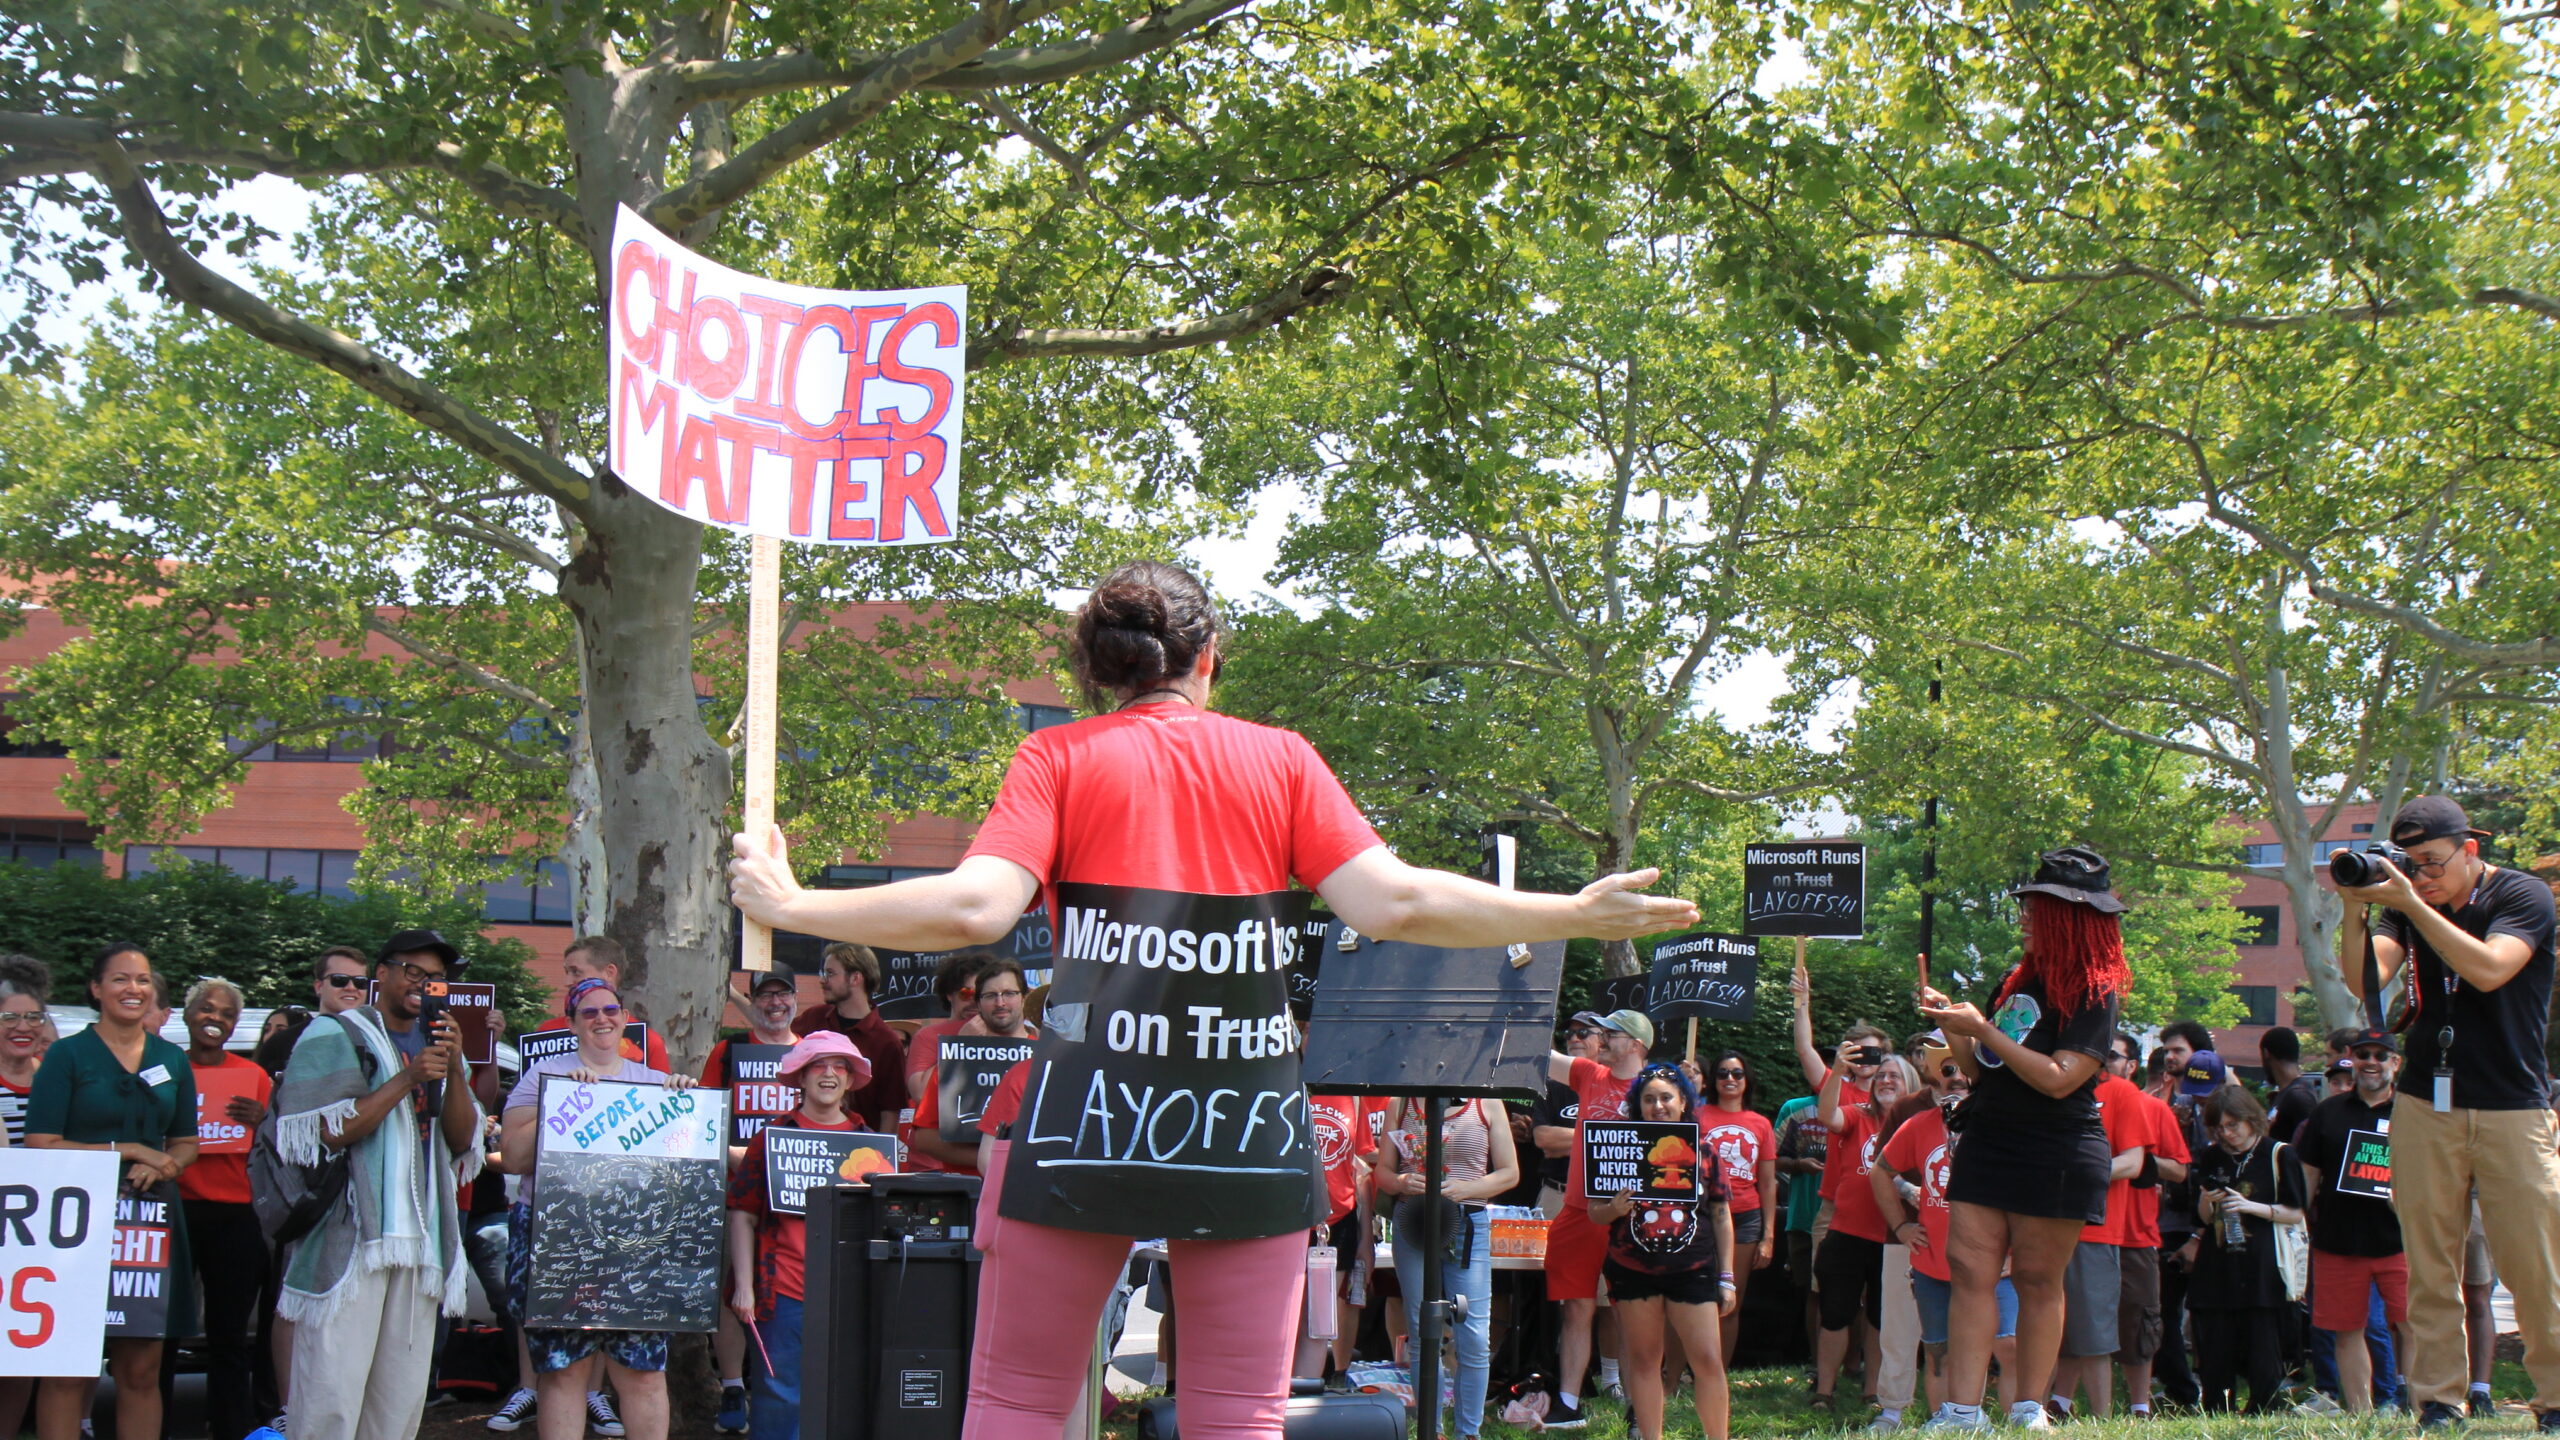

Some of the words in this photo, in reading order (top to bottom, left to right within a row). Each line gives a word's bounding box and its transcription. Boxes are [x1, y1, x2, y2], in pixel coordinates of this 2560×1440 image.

[616, 239, 960, 442] CHOICES
[618, 354, 951, 542] MATTER
[1747, 849, 1818, 865] Microsoft
[1822, 849, 1860, 865] Runs
[1773, 875, 1791, 887] on
[1794, 872, 1833, 887] Trust
[1748, 891, 1857, 919] LAYOFFS!!!
[1062, 906, 1266, 974] Microsoft
[1655, 937, 1714, 962] Microsoft
[1717, 938, 1756, 956] Runs
[891, 956, 911, 970] on
[1671, 963, 1687, 976] on
[1690, 958, 1728, 975] Trust
[449, 993, 471, 1006] UNS
[474, 994, 490, 1007] ON
[1107, 1010, 1169, 1057] on
[1186, 1002, 1294, 1059] Trust
[524, 1036, 579, 1057] LAYOFFS
[941, 1042, 1033, 1062] Microsoft
[977, 1072, 1000, 1087] on
[546, 1083, 594, 1136] DEVS
[573, 1087, 645, 1149] BEFORE
[770, 1136, 841, 1157] LAYOFFS...
[1587, 1129, 1650, 1145] LAYOFFS...
[1593, 1145, 1644, 1160] LAYOFFS
[2354, 1151, 2369, 1163] AN
[2361, 1142, 2384, 1155] THIS
[777, 1155, 835, 1175] LAYOFFS
[1599, 1161, 1638, 1176] NEVER
[1594, 1177, 1644, 1192] CHANGE
[140, 1200, 168, 1223] WE
[112, 1271, 161, 1298] WIN
[0, 1266, 57, 1349] S
